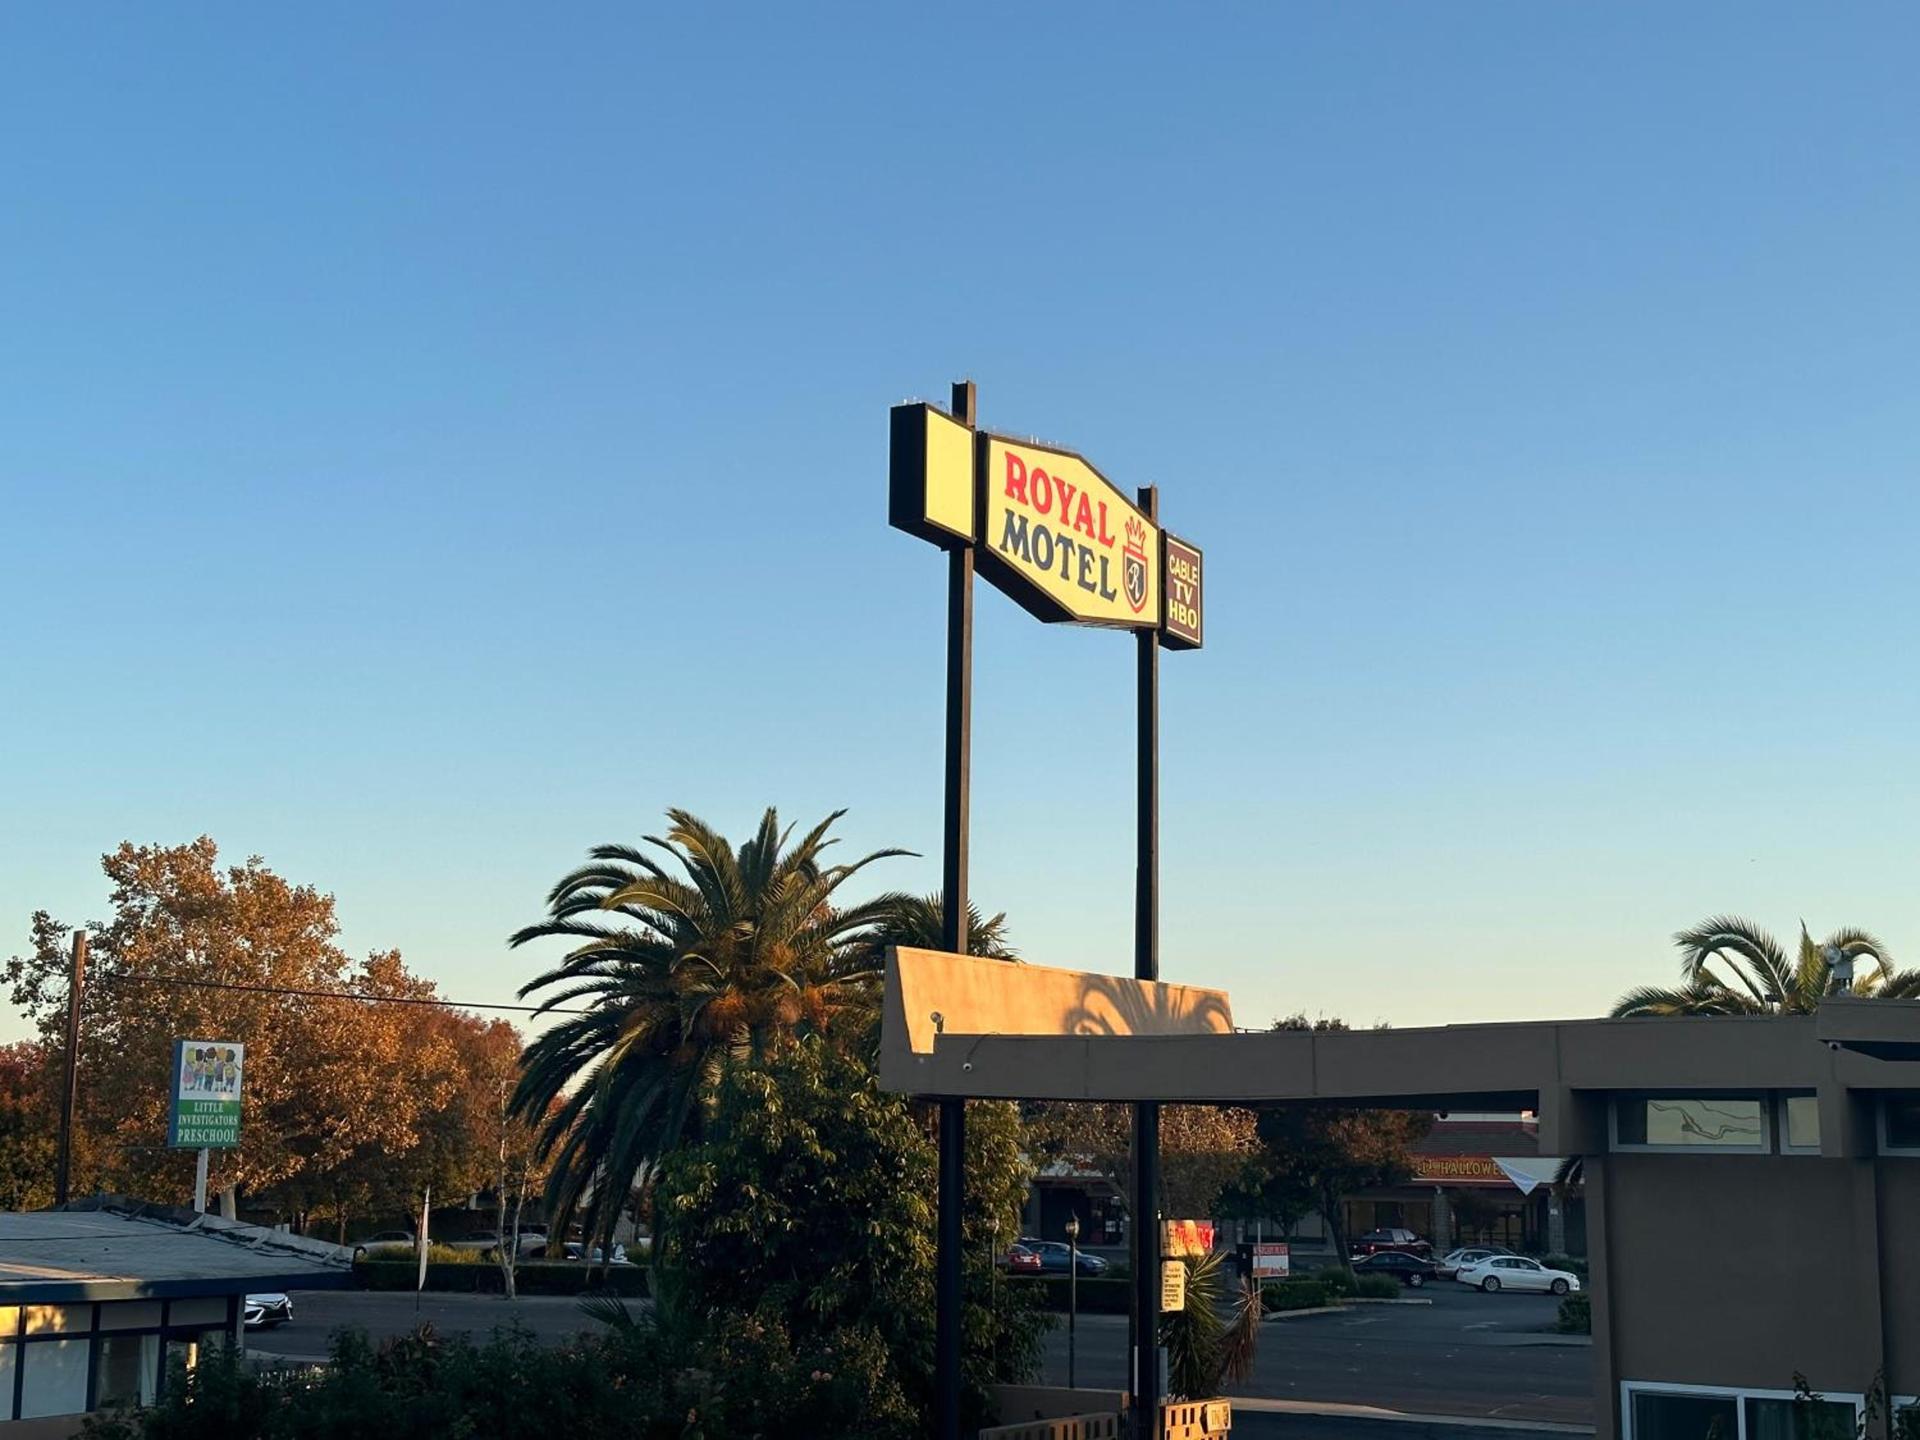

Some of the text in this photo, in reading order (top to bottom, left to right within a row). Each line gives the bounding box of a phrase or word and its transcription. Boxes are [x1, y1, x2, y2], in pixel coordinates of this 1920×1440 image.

[1004, 451, 1116, 549] ROYAL
[999, 508, 1118, 603] MOTEL
[1169, 554, 1198, 586] CABLE
[1173, 578, 1193, 605] TV
[1168, 602, 1197, 628] HBO
[178, 1114, 239, 1126] INVESTIGATORS
[194, 1102, 224, 1113] LITTLE
[177, 1128, 237, 1143] PRESCHOOL
[1440, 1160, 1505, 1176] HALLOWE
